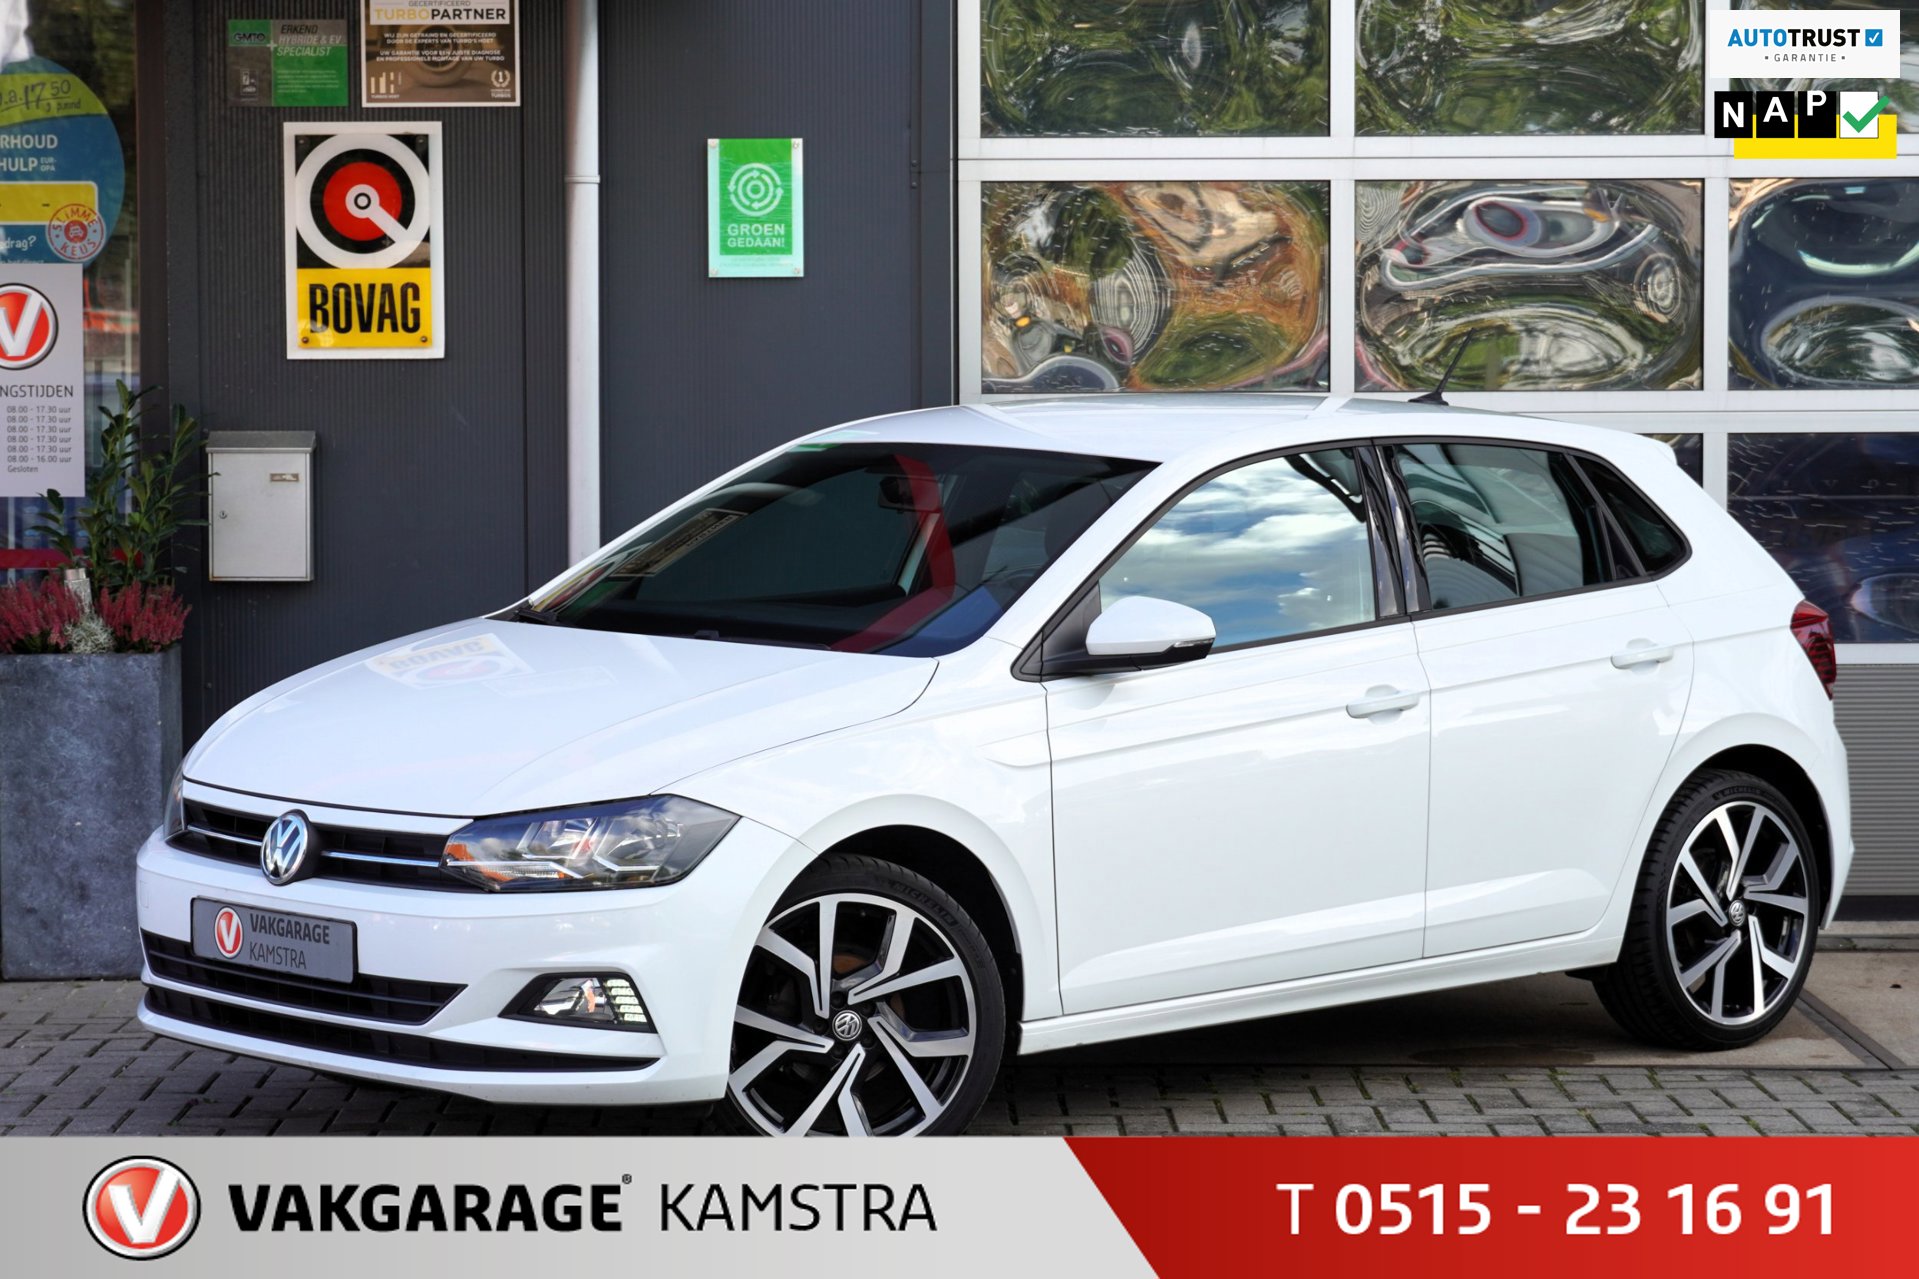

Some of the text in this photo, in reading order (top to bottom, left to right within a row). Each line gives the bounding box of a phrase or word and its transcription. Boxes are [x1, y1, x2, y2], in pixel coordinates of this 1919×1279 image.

[375, 8, 506, 20] TURBOPARTNER
[281, 24, 319, 34] ERKEND
[278, 34, 319, 44] HYBRIDE
[329, 35, 342, 44] EV
[276, 46, 332, 56] SPECIALIST
[727, 223, 785, 236] GROEN
[727, 237, 785, 248] GEDAAN!
[308, 281, 421, 334] BOVAG
[0, 384, 74, 398] NGSTIJDEN
[7, 464, 39, 473] Gesloten
[250, 913, 330, 945] VAKGARAGE
[250, 941, 307, 970] KAMSTRA
